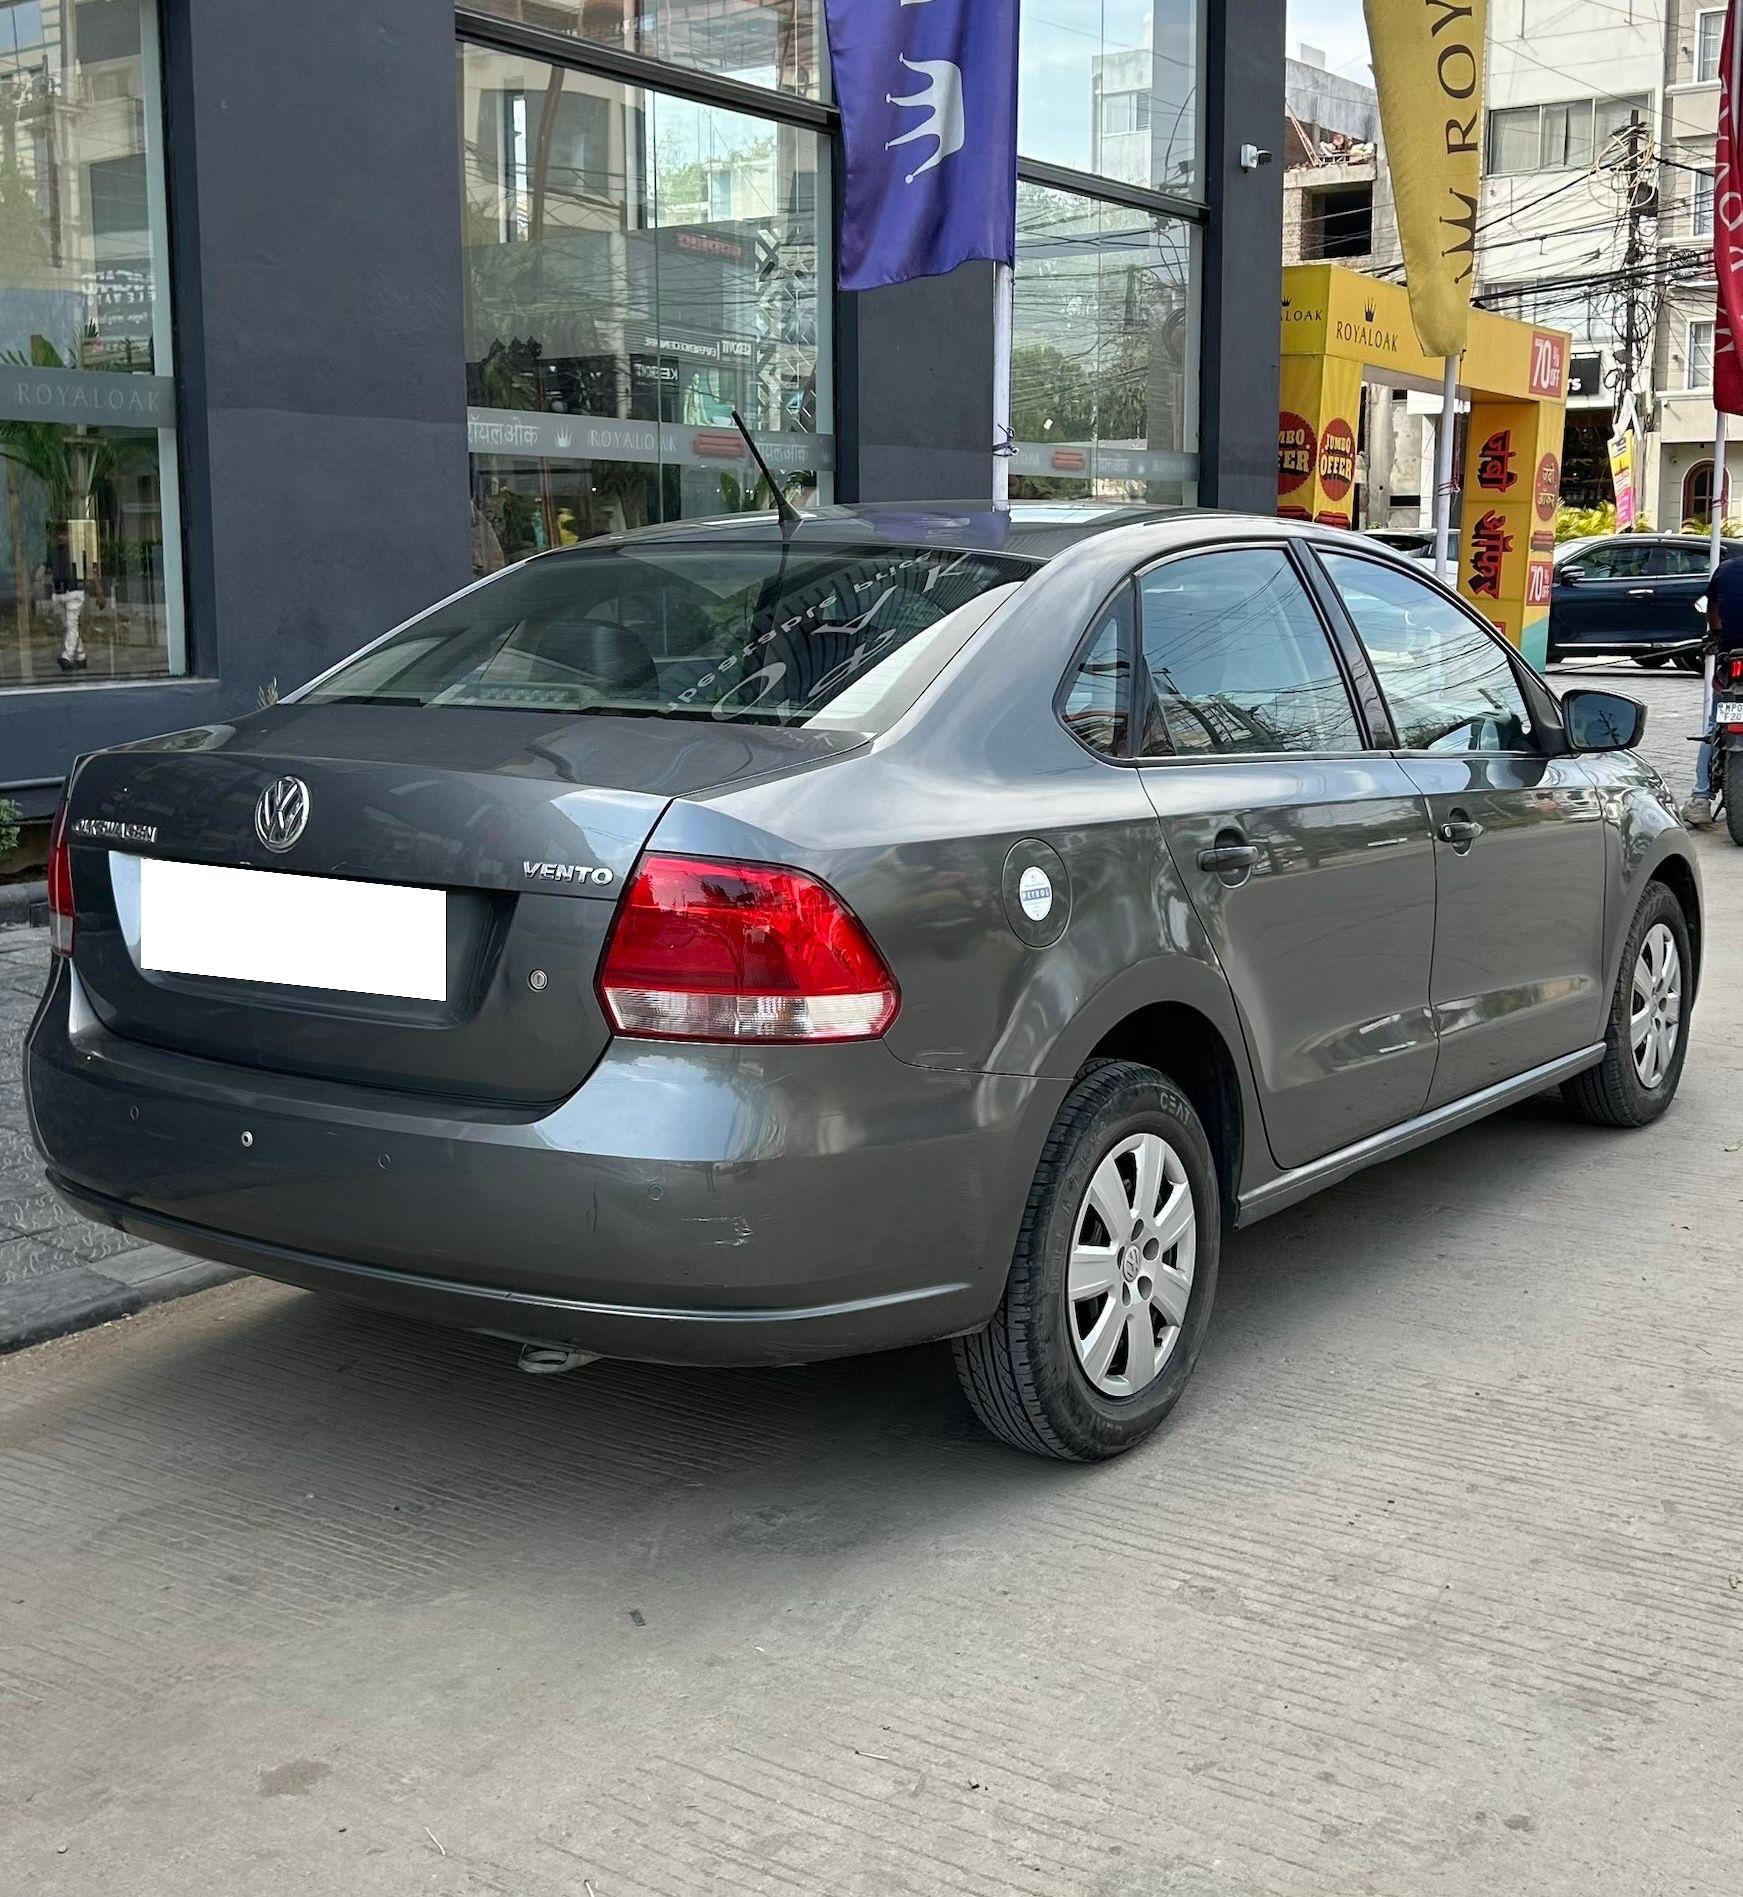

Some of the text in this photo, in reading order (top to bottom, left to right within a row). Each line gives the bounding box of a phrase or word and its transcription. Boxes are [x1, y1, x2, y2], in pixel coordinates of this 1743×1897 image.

[1336, 320, 1399, 352] ROYALOAK
[17, 382, 161, 412] ROYALOAK
[1325, 433, 1352, 454] JUMBO
[1320, 454, 1352, 482] OFFER
[72, 819, 158, 843] OLKSWAGEN
[523, 861, 614, 886] VENTO
[1022, 888, 1051, 901] PETROL
